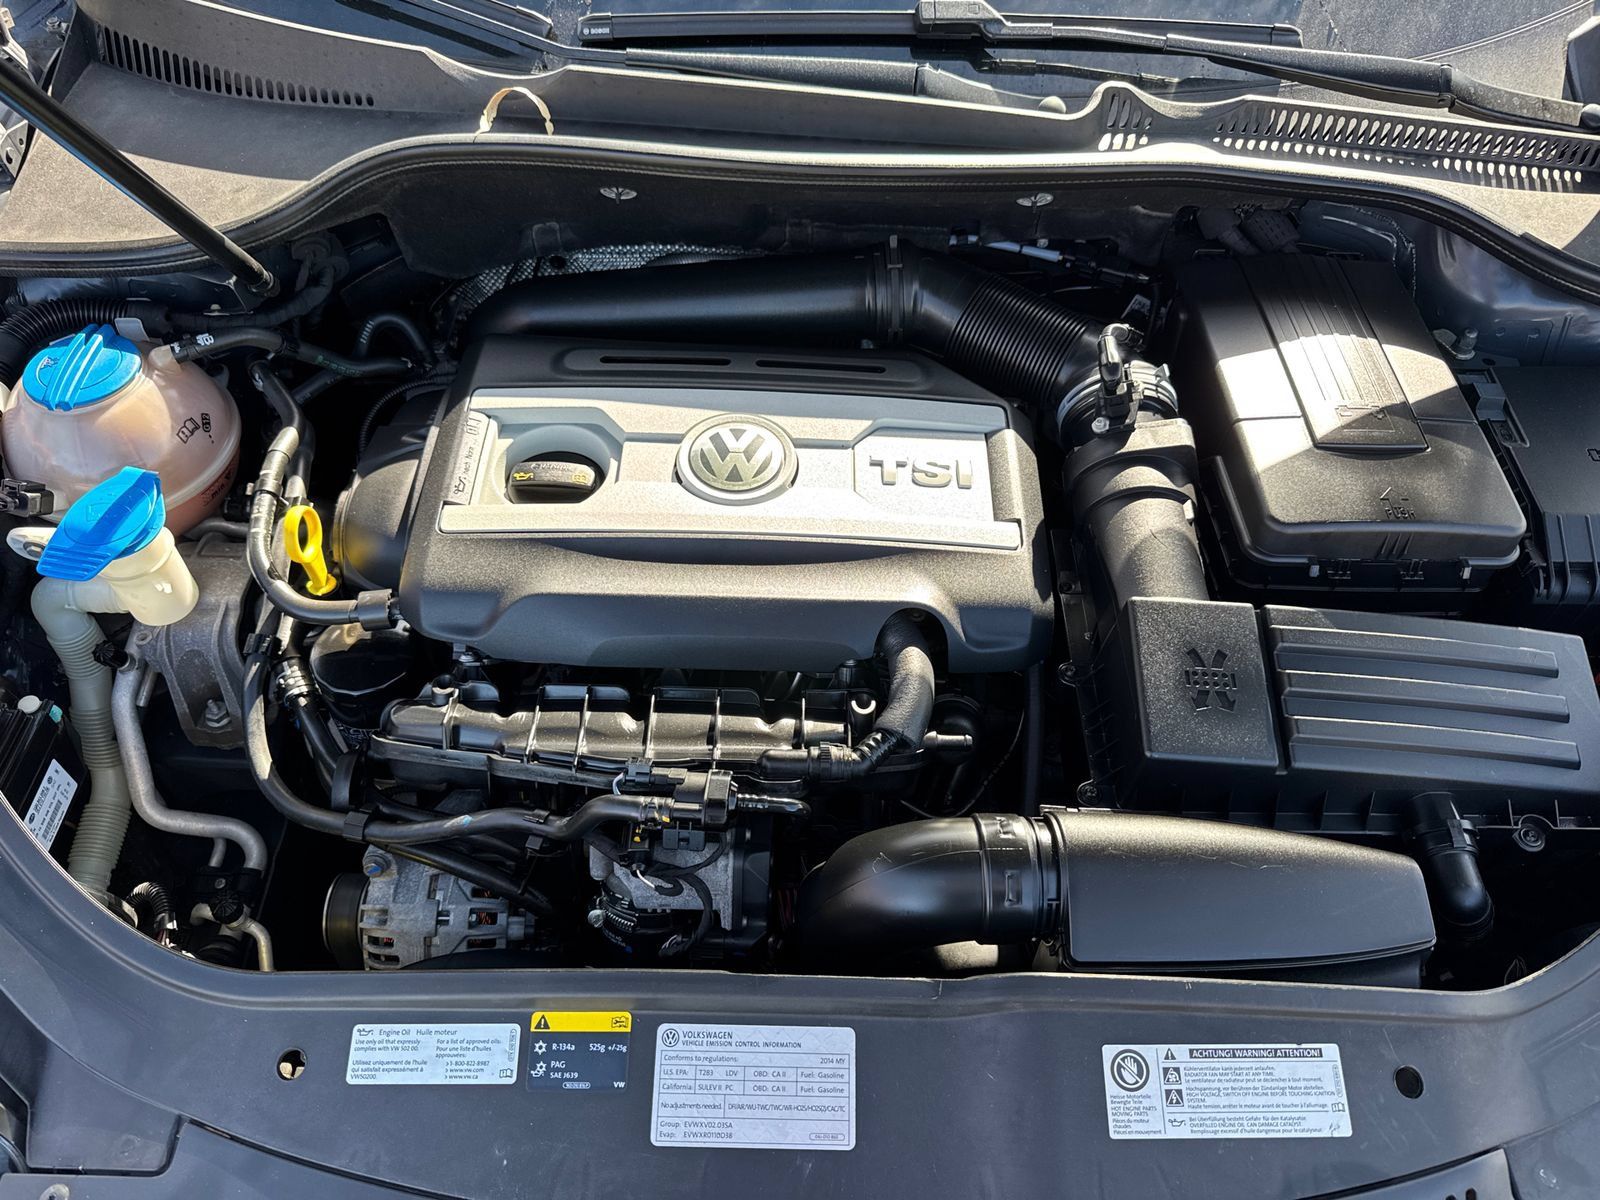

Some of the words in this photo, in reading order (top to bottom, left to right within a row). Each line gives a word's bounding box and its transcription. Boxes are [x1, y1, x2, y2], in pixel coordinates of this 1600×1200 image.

[869, 456, 973, 489] TSI
[1385, 506, 1416, 520] PUSH
[379, 1029, 400, 1037] Engine
[682, 1031, 733, 1040] VOLKSWAGEN
[552, 1043, 576, 1051] R-134a
[589, 1043, 606, 1053] 525g
[608, 1044, 628, 1053] +/-25g
[1192, 1050, 1233, 1058] ACHTUNG!
[1276, 1049, 1320, 1057] ATTENTION!
[551, 1060, 566, 1068] PAG
